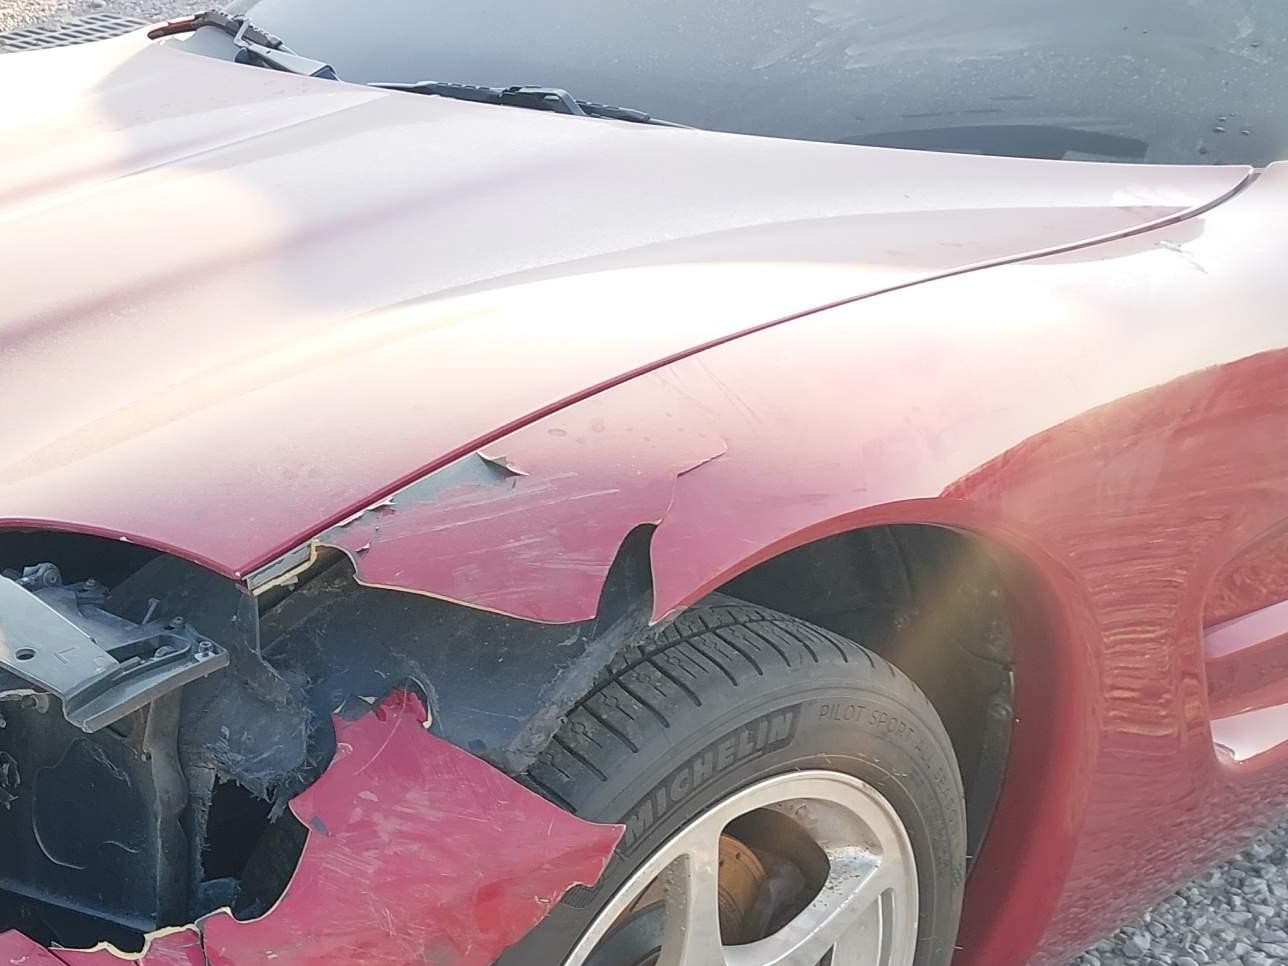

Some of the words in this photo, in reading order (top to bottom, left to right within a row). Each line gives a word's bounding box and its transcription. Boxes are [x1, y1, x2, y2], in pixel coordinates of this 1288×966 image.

[818, 703, 866, 721] PILOT
[867, 708, 915, 740] SPORT
[623, 710, 795, 850] MICHELIN
